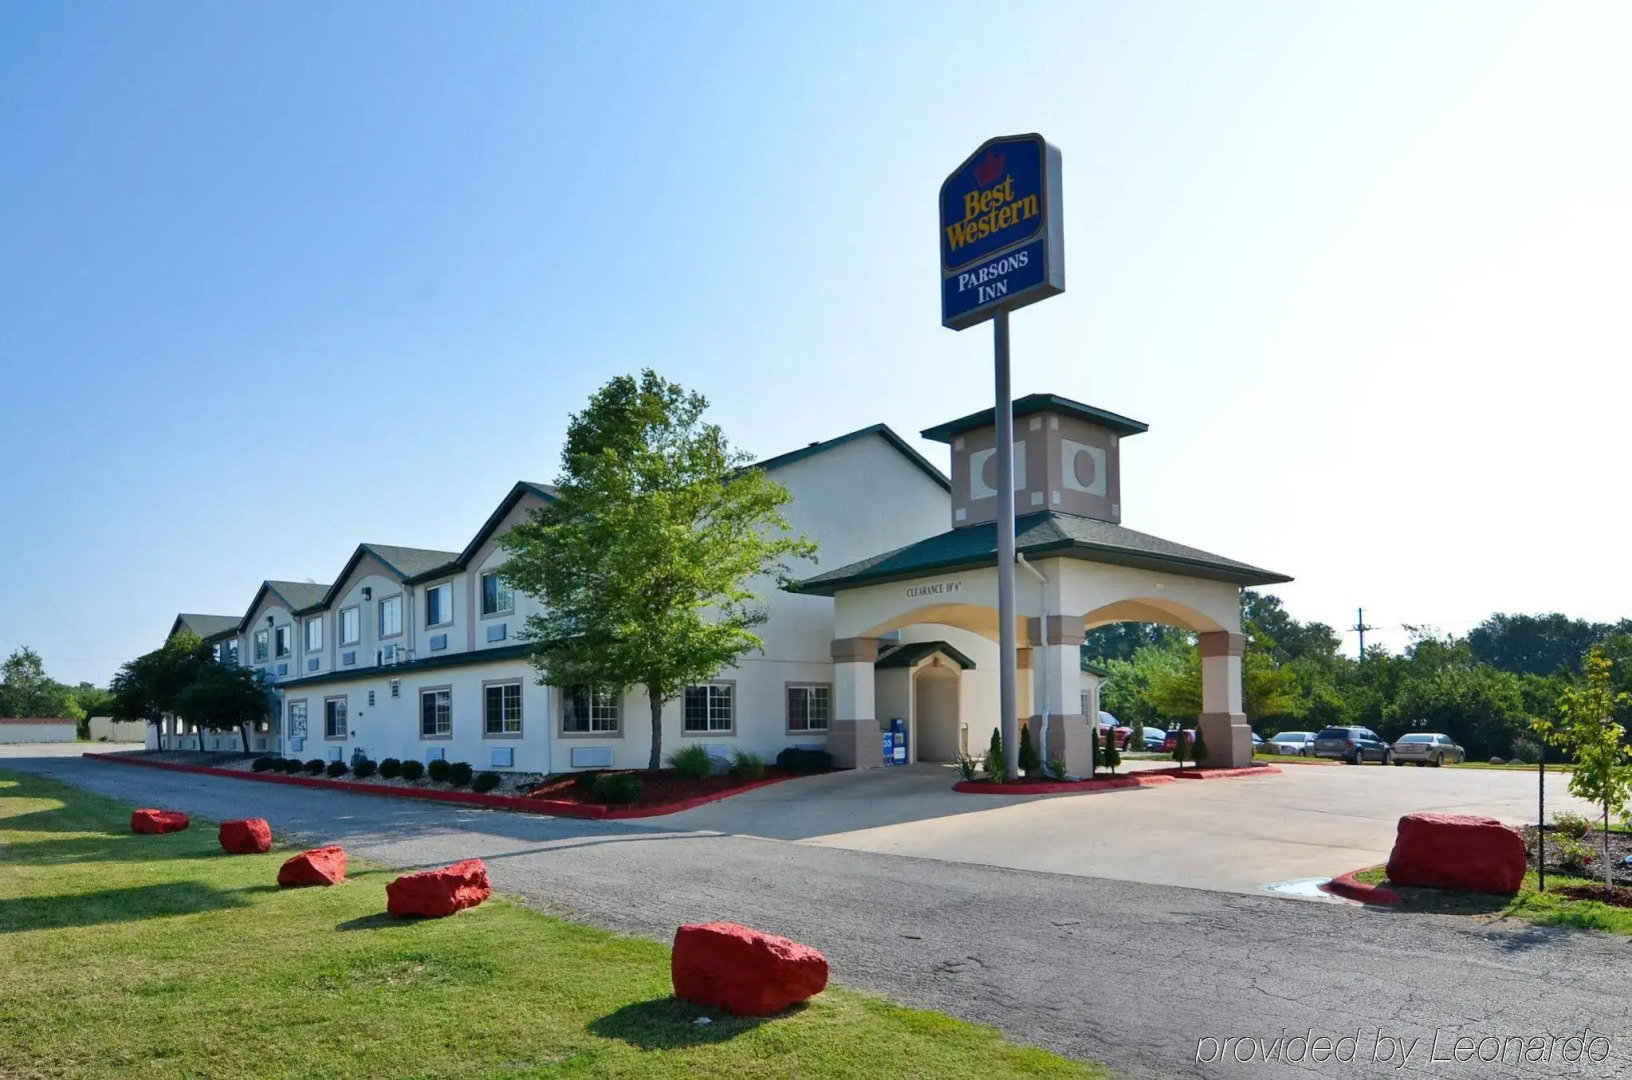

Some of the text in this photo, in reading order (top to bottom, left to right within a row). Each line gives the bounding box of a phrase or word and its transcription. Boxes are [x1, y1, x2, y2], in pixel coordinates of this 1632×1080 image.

[963, 174, 1015, 221] Best
[945, 192, 1039, 252] Western
[958, 251, 1029, 293] PARSONS
[906, 584, 943, 597] CLEARANCE
